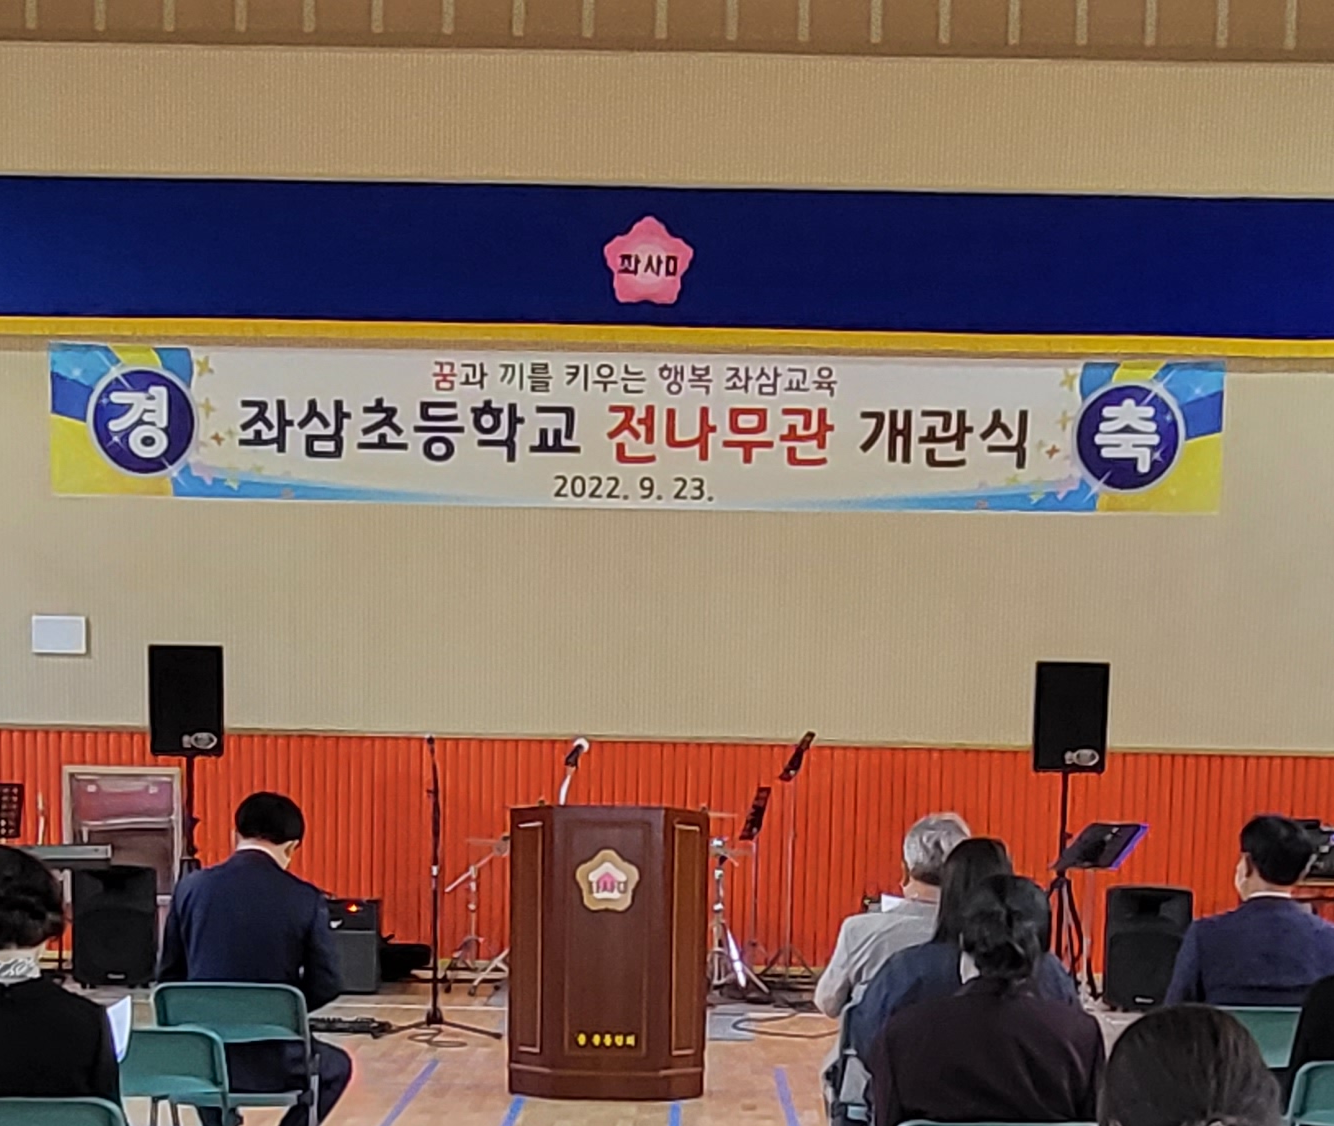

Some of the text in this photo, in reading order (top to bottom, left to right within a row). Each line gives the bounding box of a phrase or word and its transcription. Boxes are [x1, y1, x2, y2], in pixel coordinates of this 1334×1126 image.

[431, 361, 838, 398] 꿈과 끼를 키우는 행복 좌삼교육
[106, 385, 171, 460] 경
[238, 396, 1030, 470] 좌삼초등학교 전나무관 개관식
[1092, 398, 1162, 475] 축
[553, 475, 715, 502] 2022. 9. 23.
